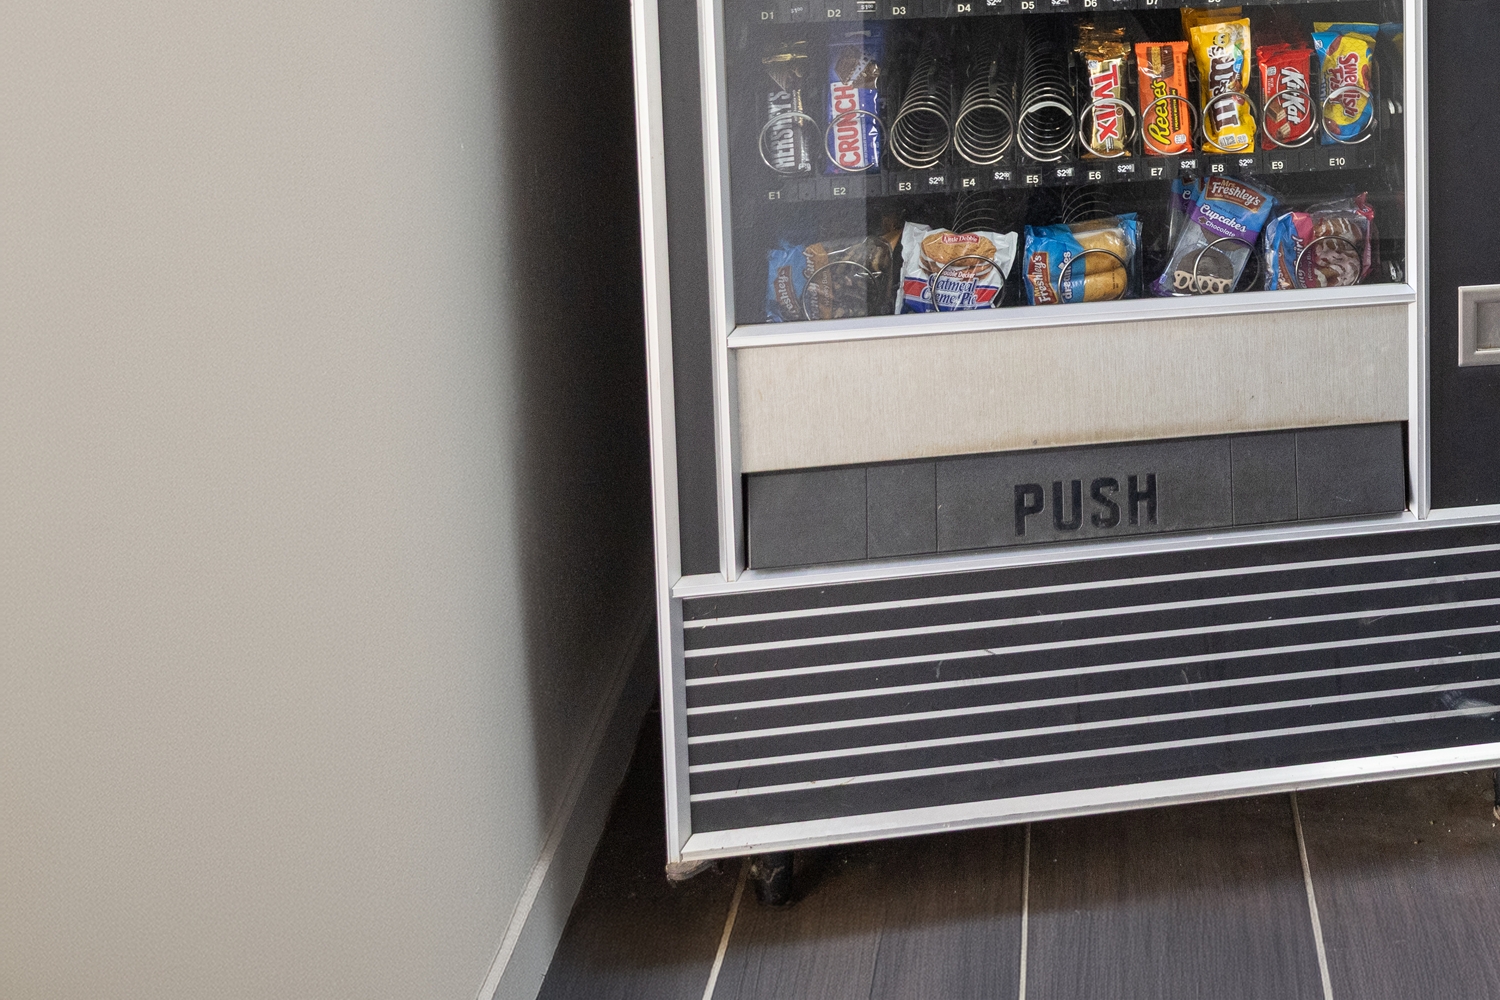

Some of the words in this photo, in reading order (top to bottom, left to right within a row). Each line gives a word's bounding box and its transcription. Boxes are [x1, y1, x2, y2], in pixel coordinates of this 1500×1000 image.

[1021, 1, 1035, 10] D5
[1084, 0, 1097, 7] D6
[893, 6, 906, 15] D3
[957, 4, 971, 13] D4
[761, 12, 774, 20] D1
[827, 9, 841, 18] D2
[834, 83, 861, 168] CRUNCH
[1272, 161, 1283, 170] E9
[1329, 158, 1345, 166] E10
[1151, 168, 1163, 176] E7
[1212, 164, 1224, 173] E8
[1026, 175, 1039, 184] E5
[1088, 171, 1101, 180] E6
[899, 182, 912, 191] E3
[963, 178, 976, 188] E4
[768, 191, 781, 200] E1
[833, 187, 846, 196] E2
[1211, 181, 1262, 207] Freshley's
[1200, 203, 1247, 233] Cupcakes
[1205, 220, 1236, 238] Chocolate
[1014, 472, 1159, 537] PUSH
